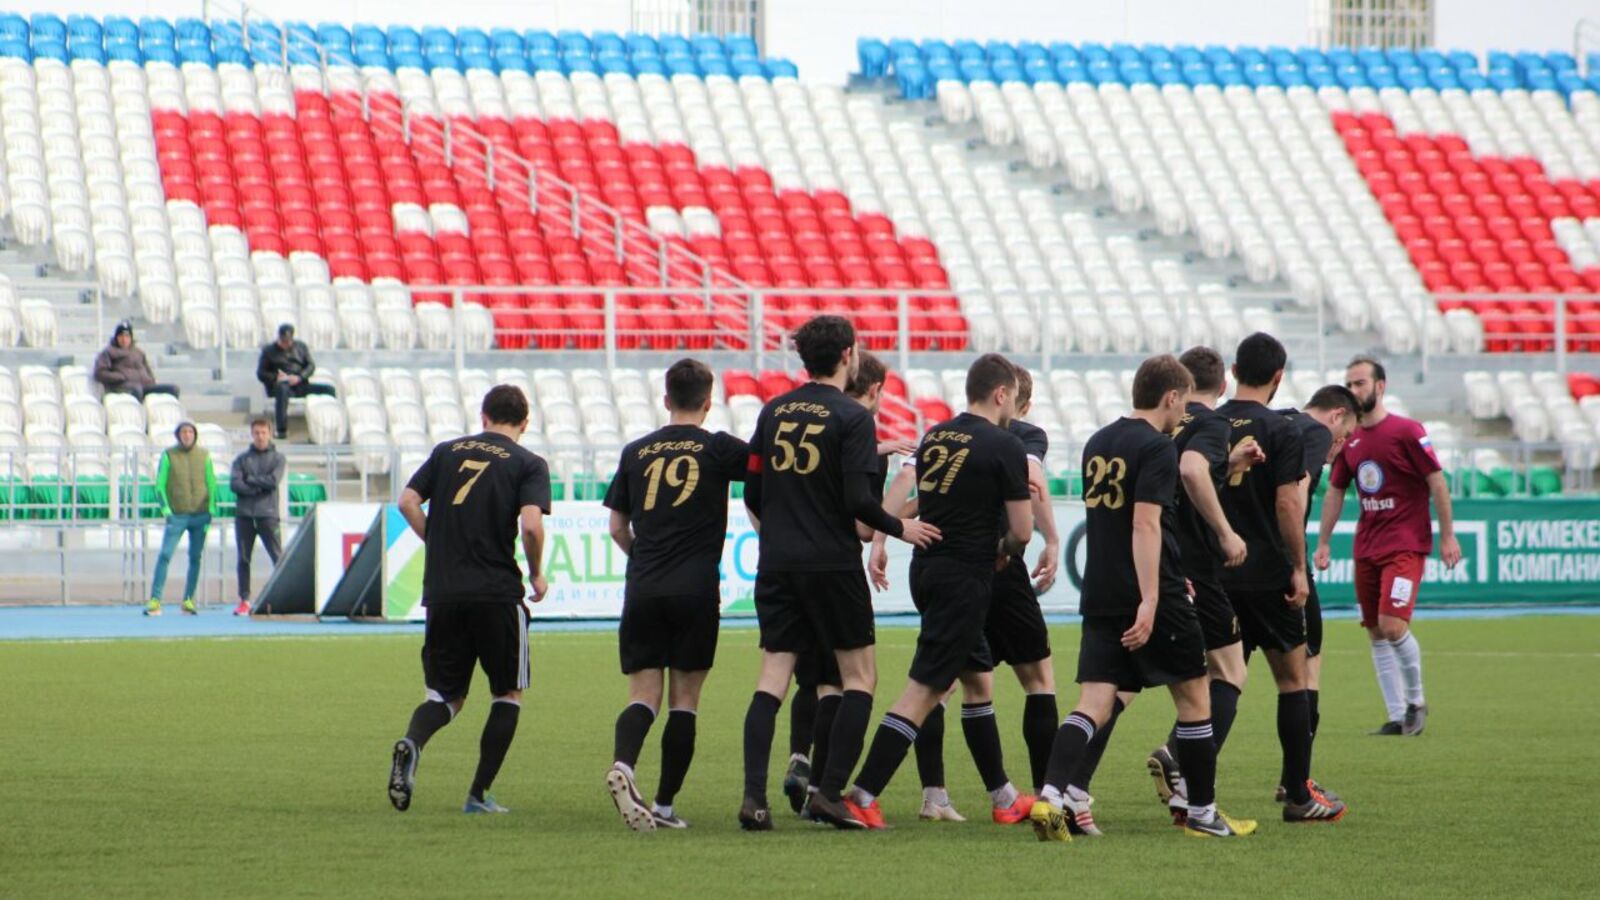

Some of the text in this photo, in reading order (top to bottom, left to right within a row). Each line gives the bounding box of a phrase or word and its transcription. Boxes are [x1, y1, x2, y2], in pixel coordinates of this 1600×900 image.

[770, 421, 826, 475] 55
[918, 445, 970, 494] 21
[452, 459, 491, 505] 7
[643, 455, 700, 511] 19
[1085, 456, 1127, 510] 23
[1498, 520, 1600, 549] БУКМЕКЕ
[1498, 554, 1600, 582] КОМПАНИ
